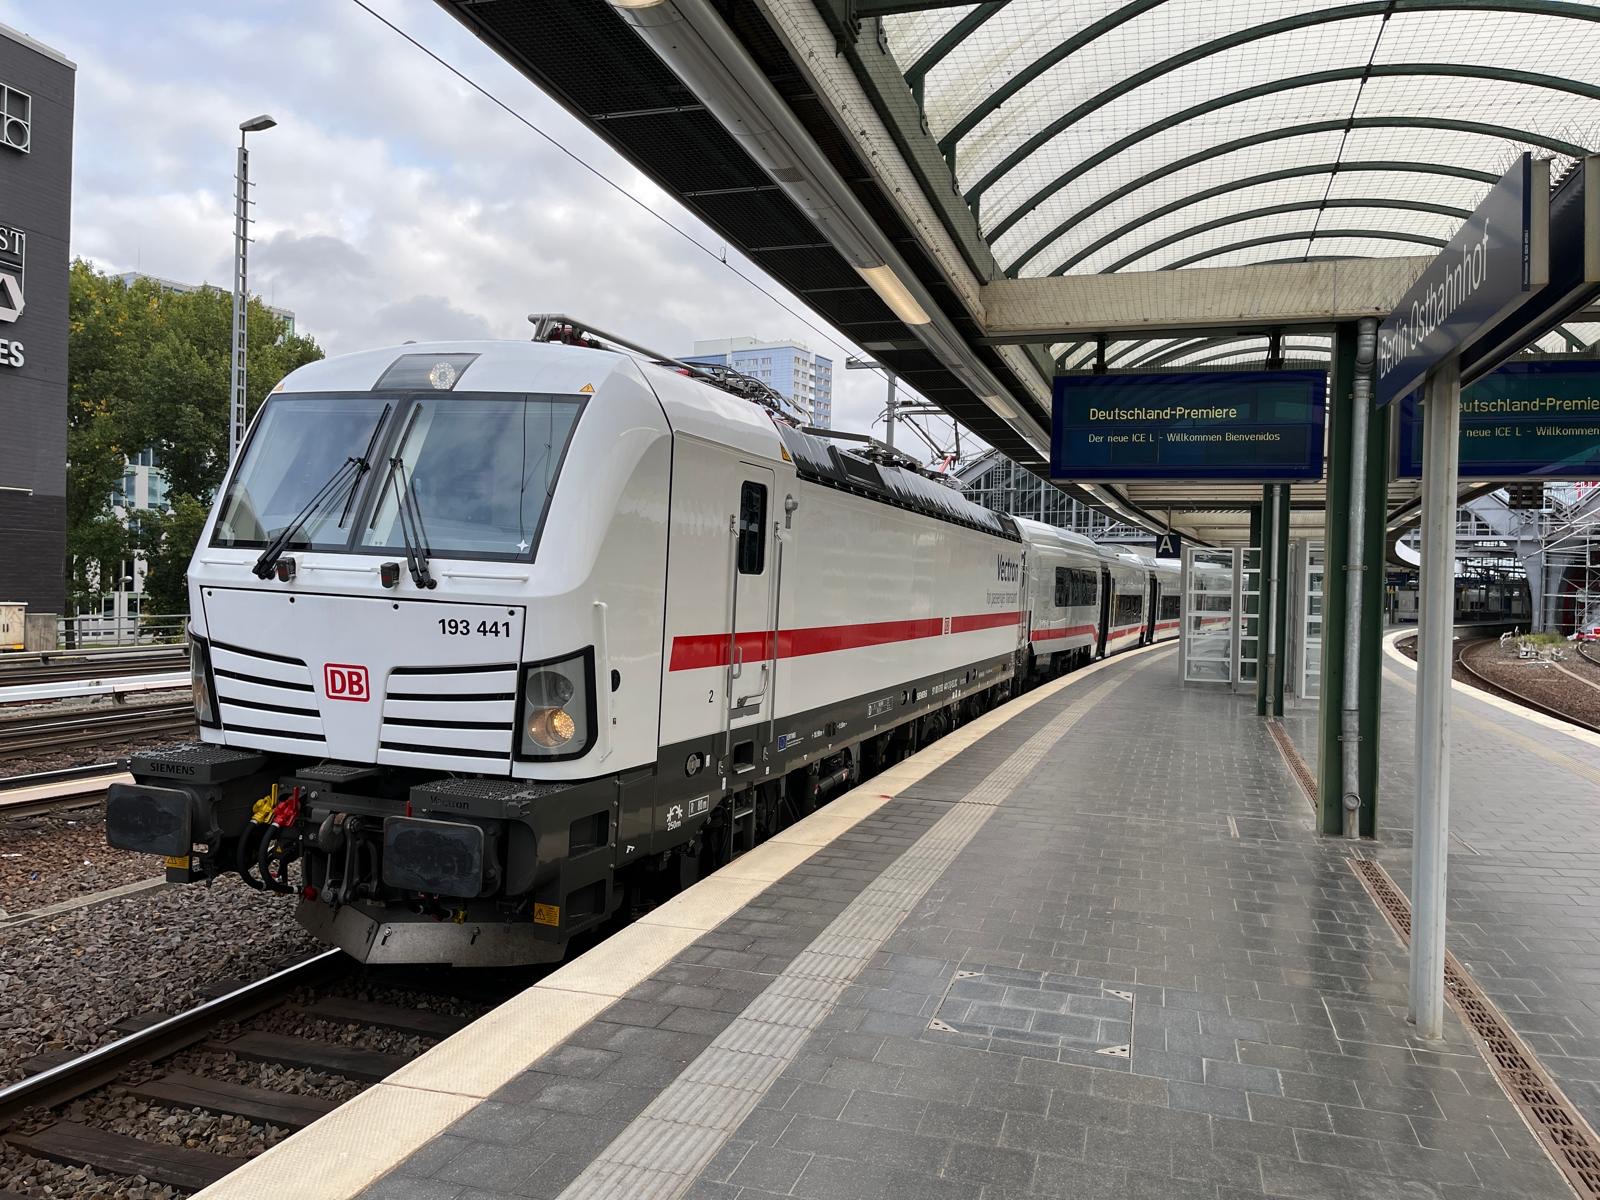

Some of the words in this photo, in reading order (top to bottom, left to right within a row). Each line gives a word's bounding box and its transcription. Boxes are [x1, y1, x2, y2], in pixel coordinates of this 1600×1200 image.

[1380, 317, 1408, 379] Berlin
[1410, 217, 1490, 351] Ostbahnhof
[1089, 405, 1237, 421] Deutschland-Premiere
[1088, 433, 1104, 443] Der
[1107, 434, 1129, 443] neue
[1131, 432, 1146, 442] ICE
[1149, 432, 1154, 442] L
[1166, 432, 1222, 442] Willkommen
[1225, 431, 1281, 442] Bienvenidos
[1466, 429, 1491, 437] neue
[1495, 427, 1511, 437] ICE
[1515, 427, 1522, 436] L
[1536, 426, 1600, 436] Willkommen
[1158, 535, 1174, 553] A
[997, 553, 1019, 582] Vectron
[438, 618, 471, 636] 193
[476, 620, 511, 638] 441
[328, 668, 366, 697] DB
[708, 689, 714, 704] 2
[150, 762, 195, 776] SIEMENS
